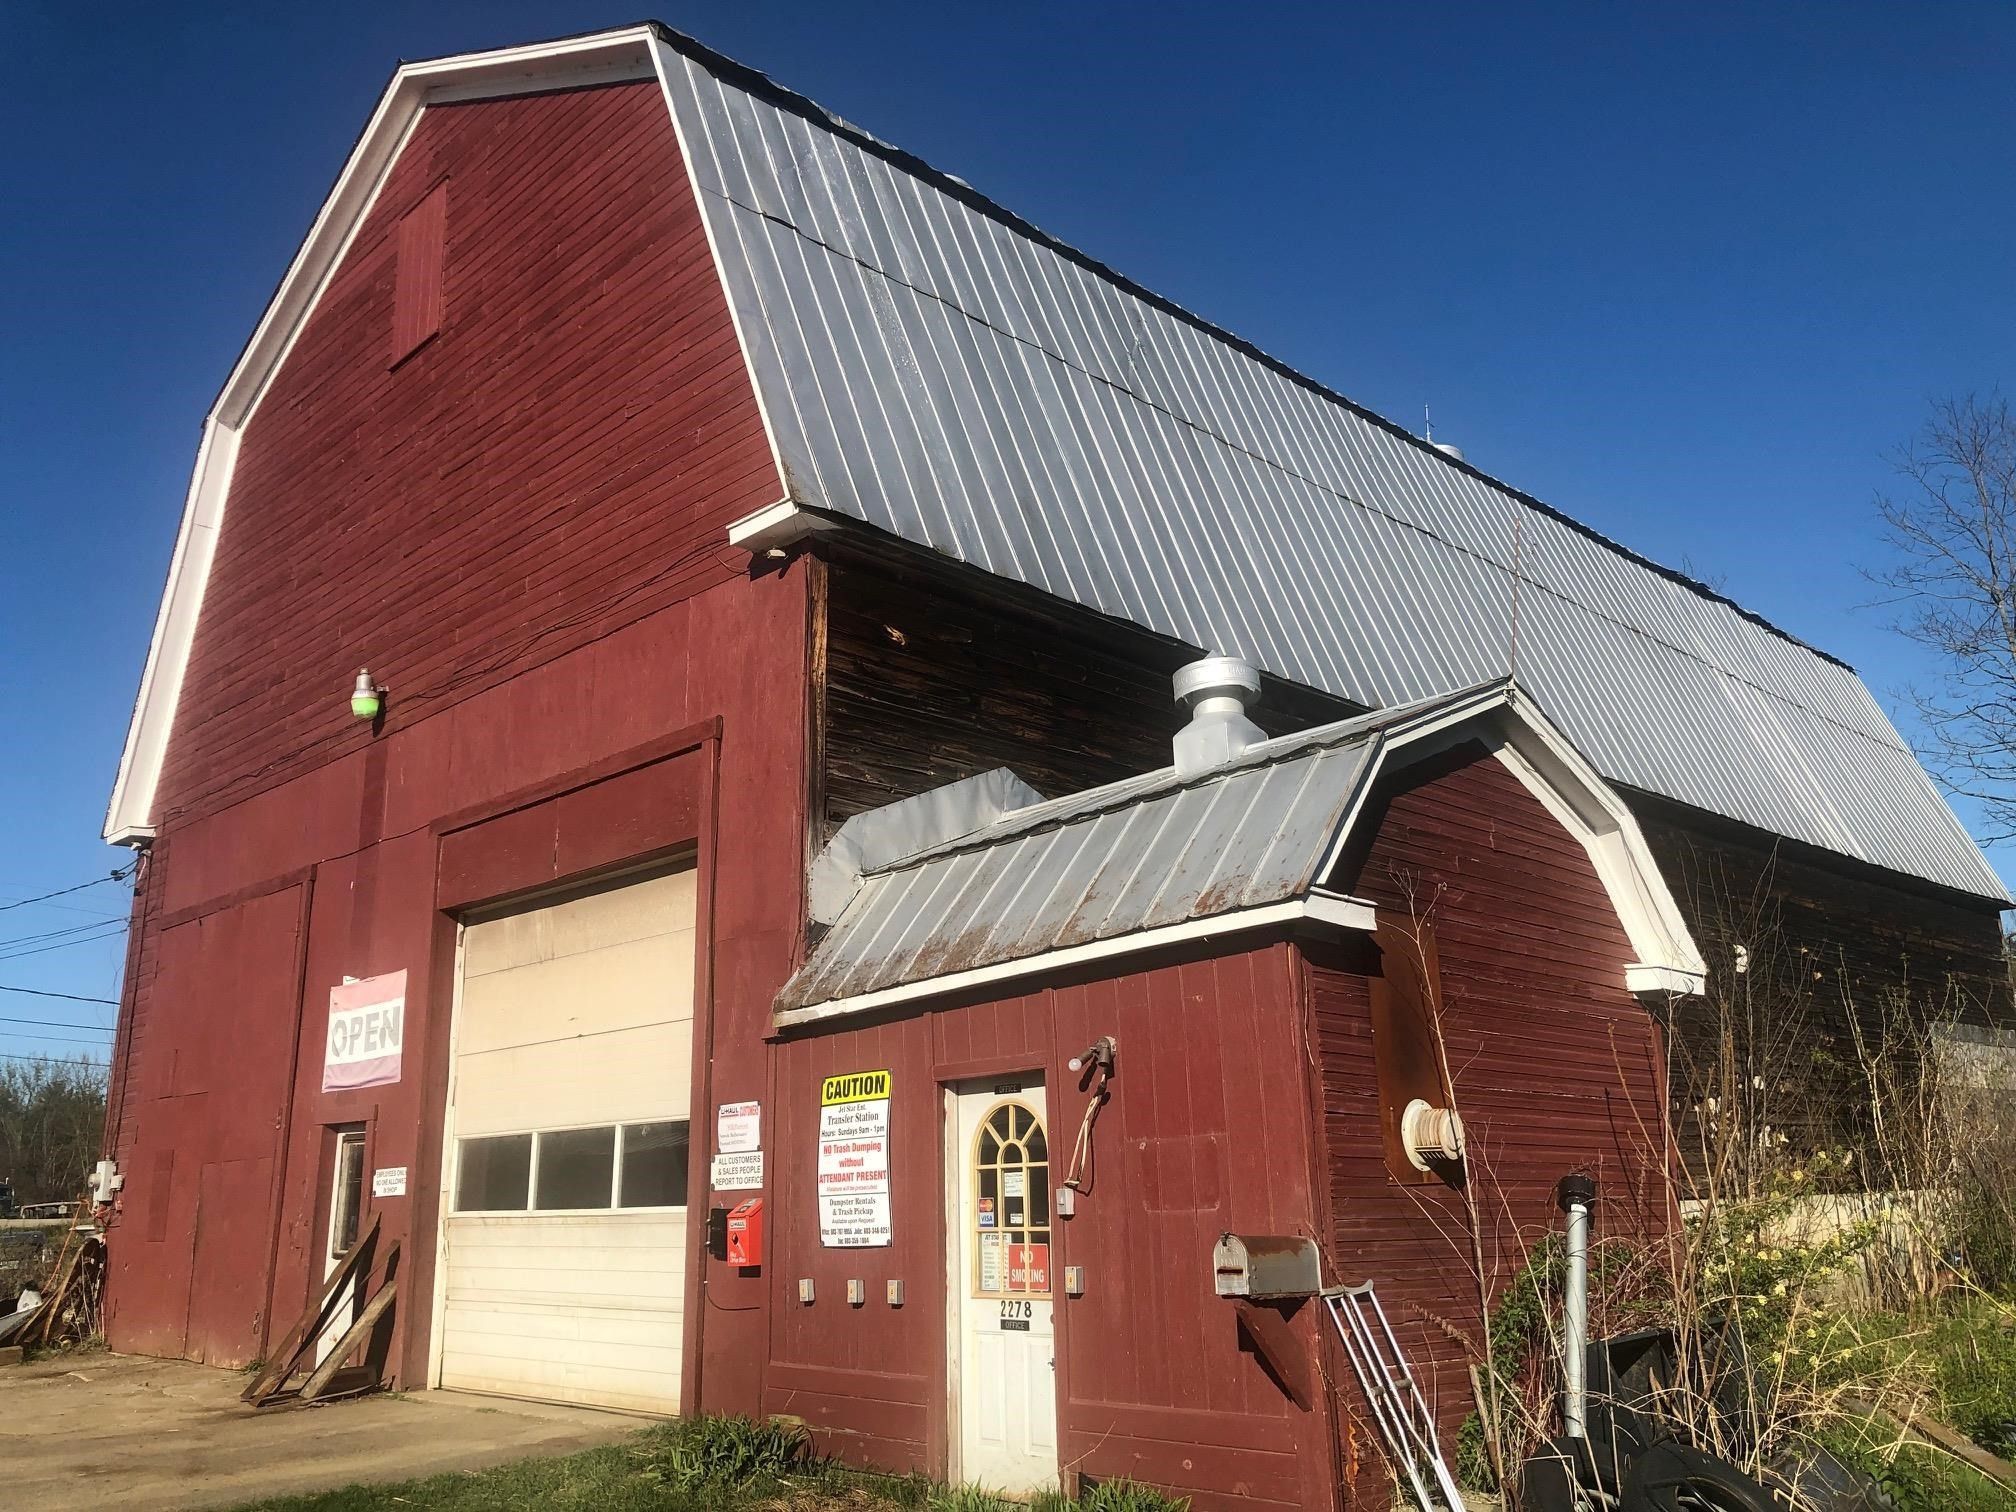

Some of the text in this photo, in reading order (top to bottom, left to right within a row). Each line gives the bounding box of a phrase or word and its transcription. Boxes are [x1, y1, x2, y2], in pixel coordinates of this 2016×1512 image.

[331, 1005, 401, 1057] OPEN
[826, 1075, 886, 1100] CAUTION
[828, 1112, 879, 1125] Transfer Station
[838, 1127, 858, 1136] Sundays
[859, 1126, 869, 1134] 9am
[873, 1125, 885, 1134] 1pm
[823, 1141, 882, 1155] NO Trash Dumping
[719, 1155, 761, 1165] ALL CUSTOMERS
[839, 1157, 864, 1167] without
[723, 1166, 739, 1175] SALES
[740, 1165, 761, 1174] PEOPLE
[715, 1177, 735, 1185] REPORT
[743, 1175, 763, 1185] OFFICE
[819, 1170, 887, 1184] ATTENDANT PRESENT
[829, 1197, 876, 1207] Dumpster Rentals
[854, 1207, 874, 1215] Pickup
[1020, 1250, 1034, 1263] NO
[1011, 1268, 1045, 1283] SMOING
[1000, 1300, 1032, 1318] 2278
[1005, 1321, 1025, 1329] OFFICE
